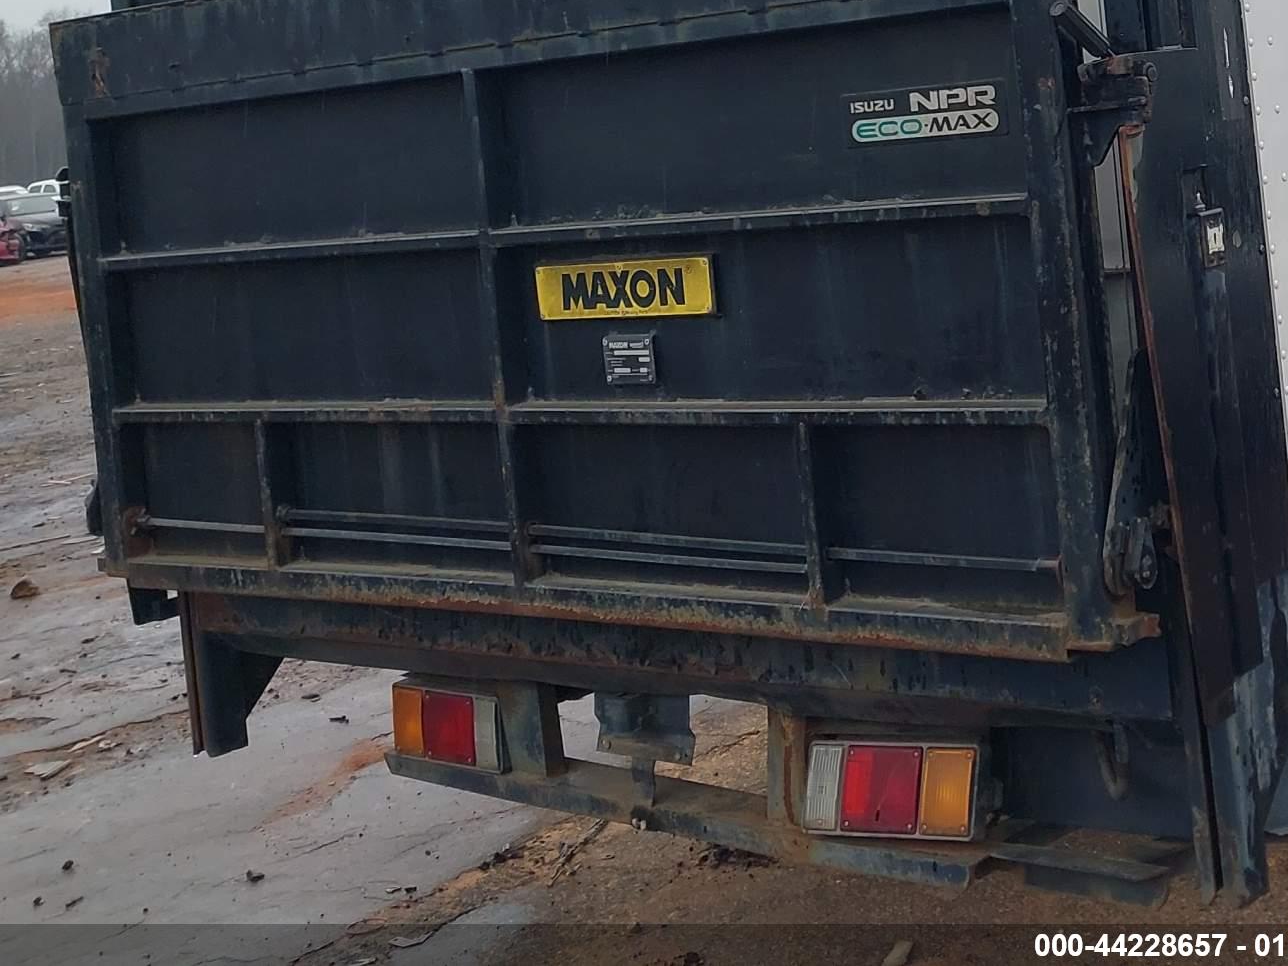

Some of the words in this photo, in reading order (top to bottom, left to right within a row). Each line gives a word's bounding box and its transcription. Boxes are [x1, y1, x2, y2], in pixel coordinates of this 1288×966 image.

[850, 98, 895, 114] ISUZU
[909, 85, 997, 112] NPR
[561, 267, 686, 311] MAXON
